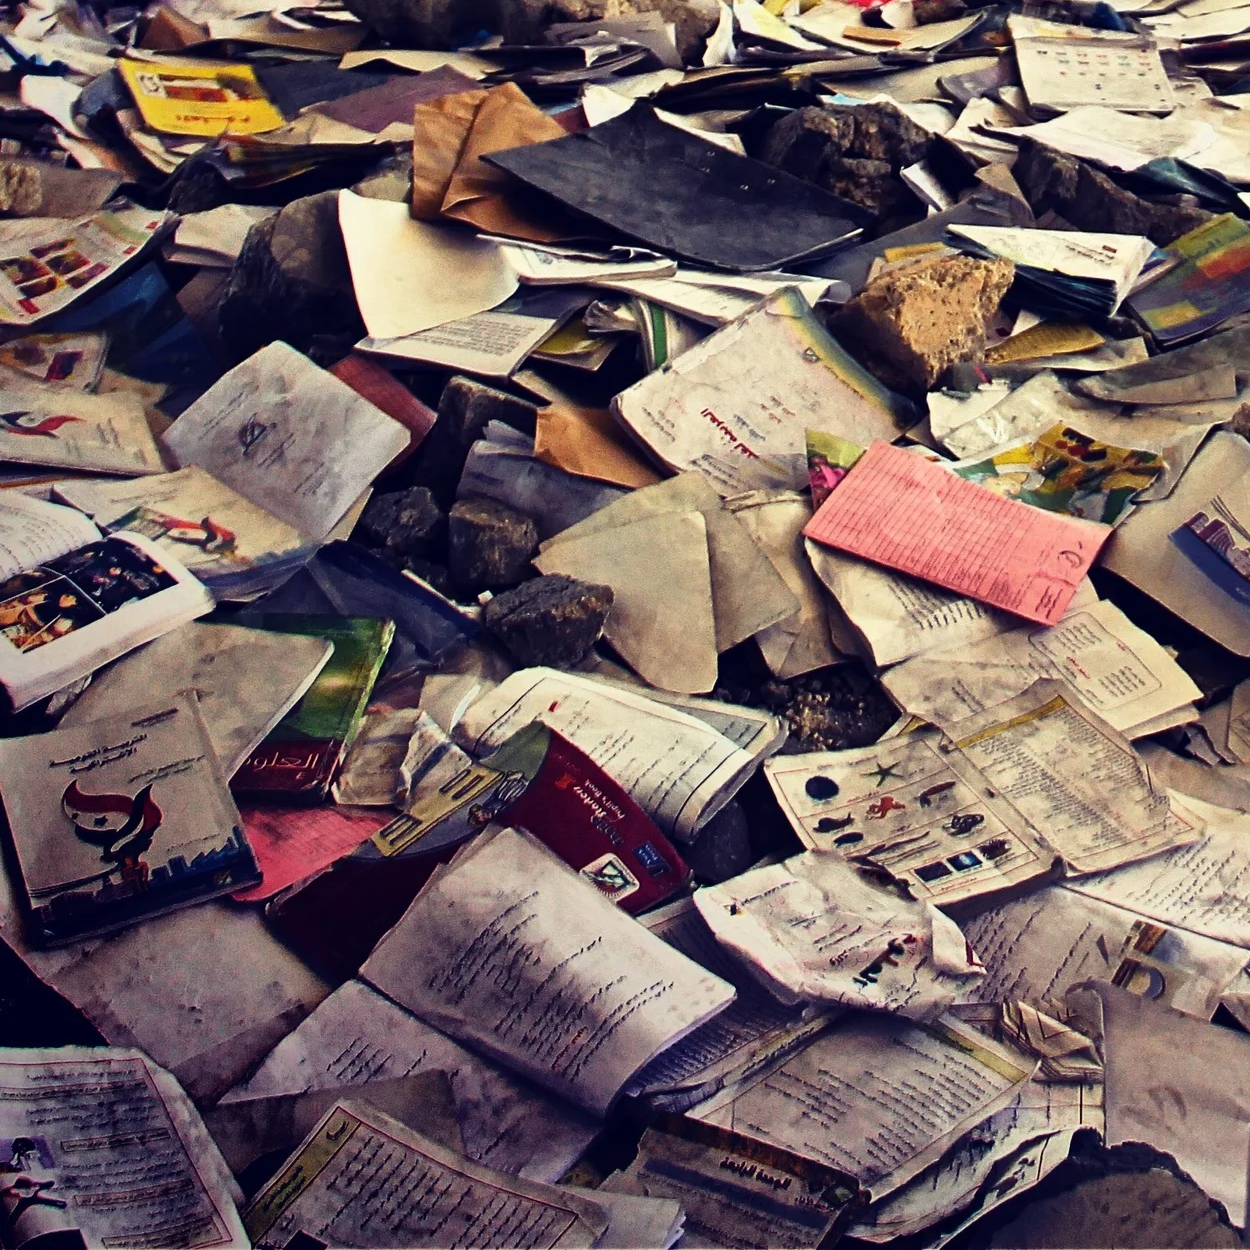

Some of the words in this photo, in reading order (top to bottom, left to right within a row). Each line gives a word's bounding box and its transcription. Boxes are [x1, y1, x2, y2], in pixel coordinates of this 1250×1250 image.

[584, 778, 603, 798] Book
[601, 795, 626, 820] Pupil's
[719, 1156, 757, 1178] الرابعة
[756, 1168, 793, 1191] الوحدة
